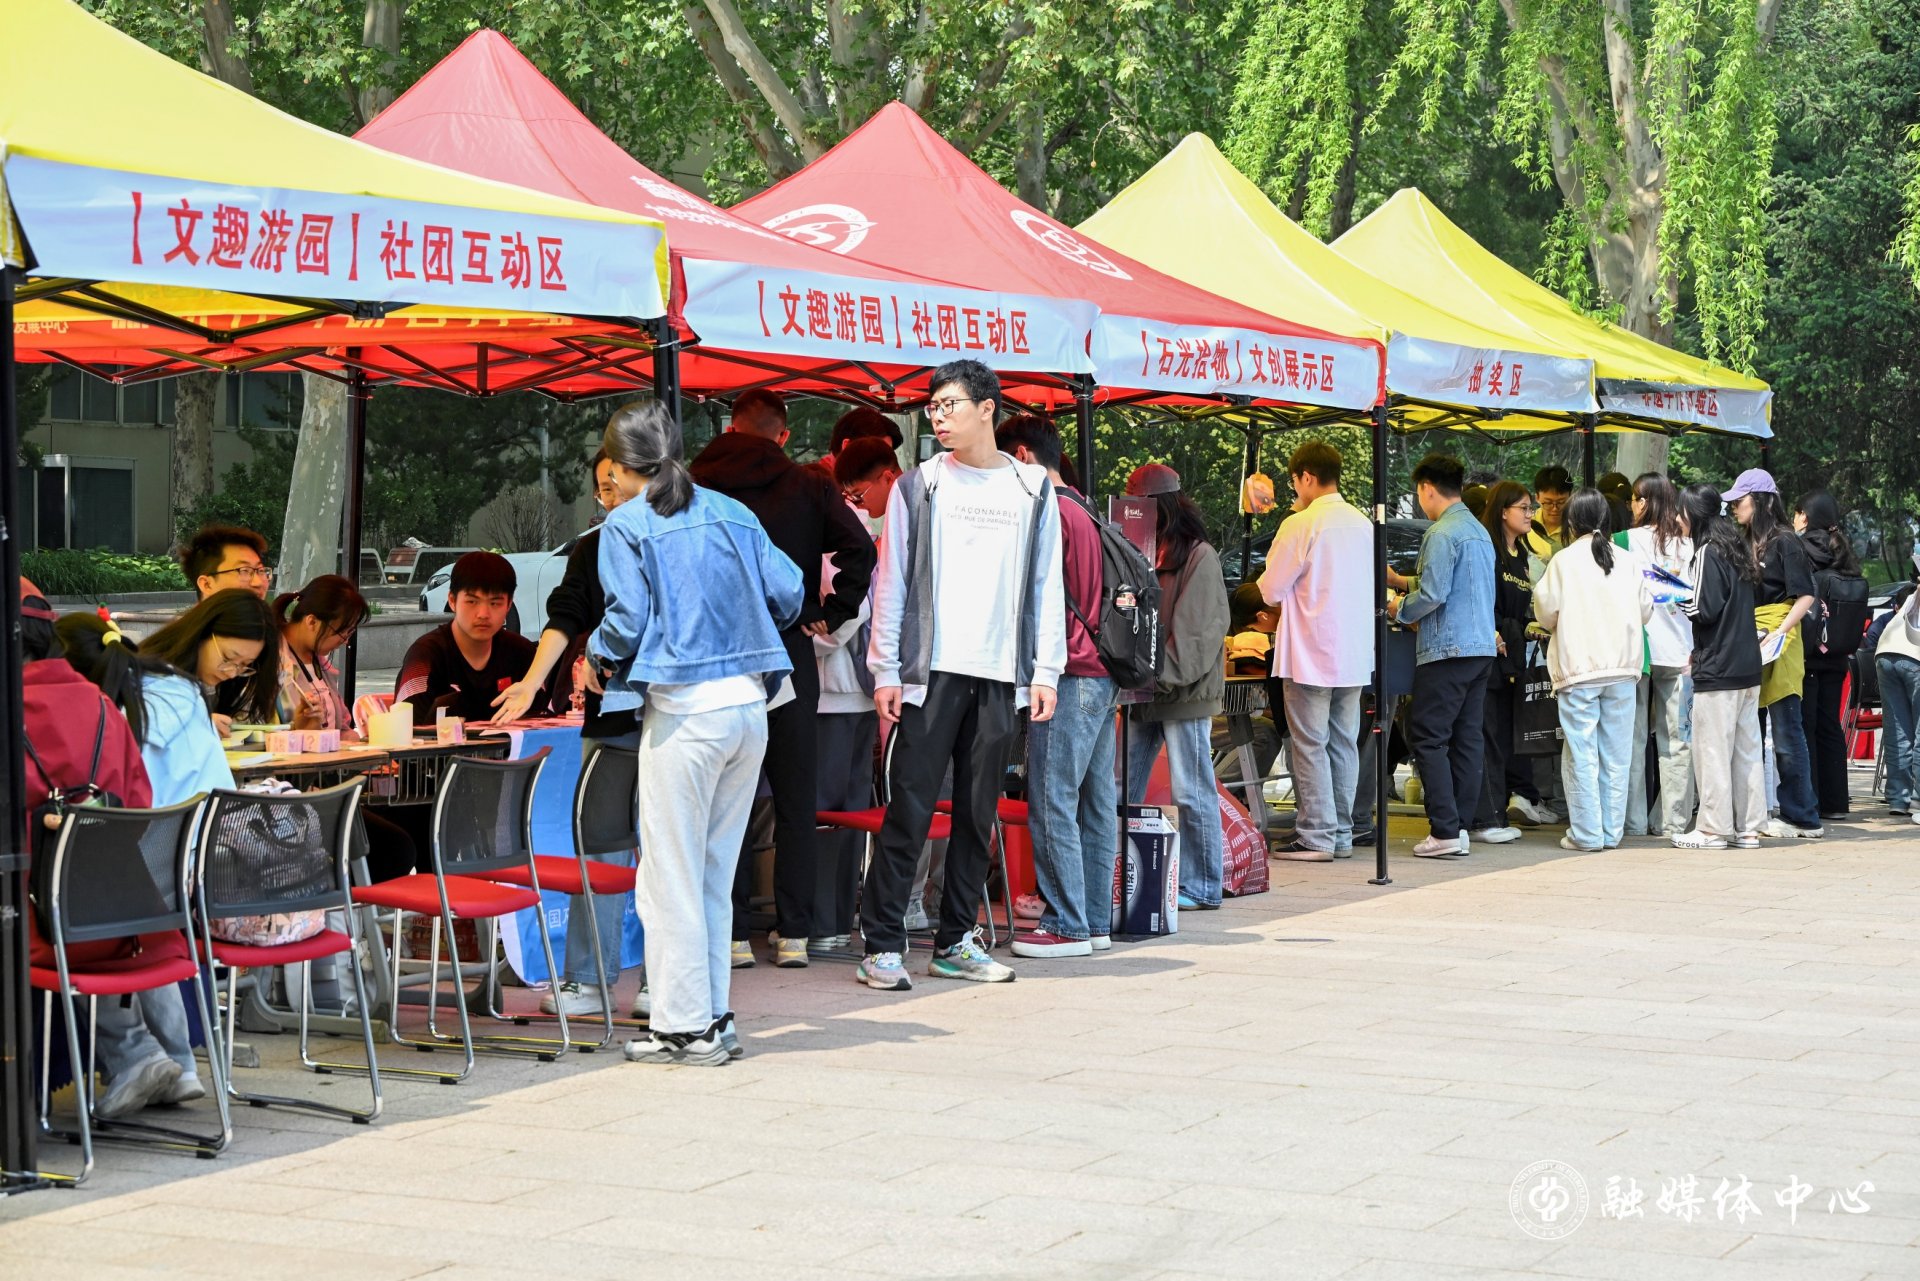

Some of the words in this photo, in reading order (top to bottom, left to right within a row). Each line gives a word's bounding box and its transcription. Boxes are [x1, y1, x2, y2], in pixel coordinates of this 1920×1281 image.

[1468, 359, 1523, 397] 抽奖区
[1677, 840, 1700, 849] crocs
